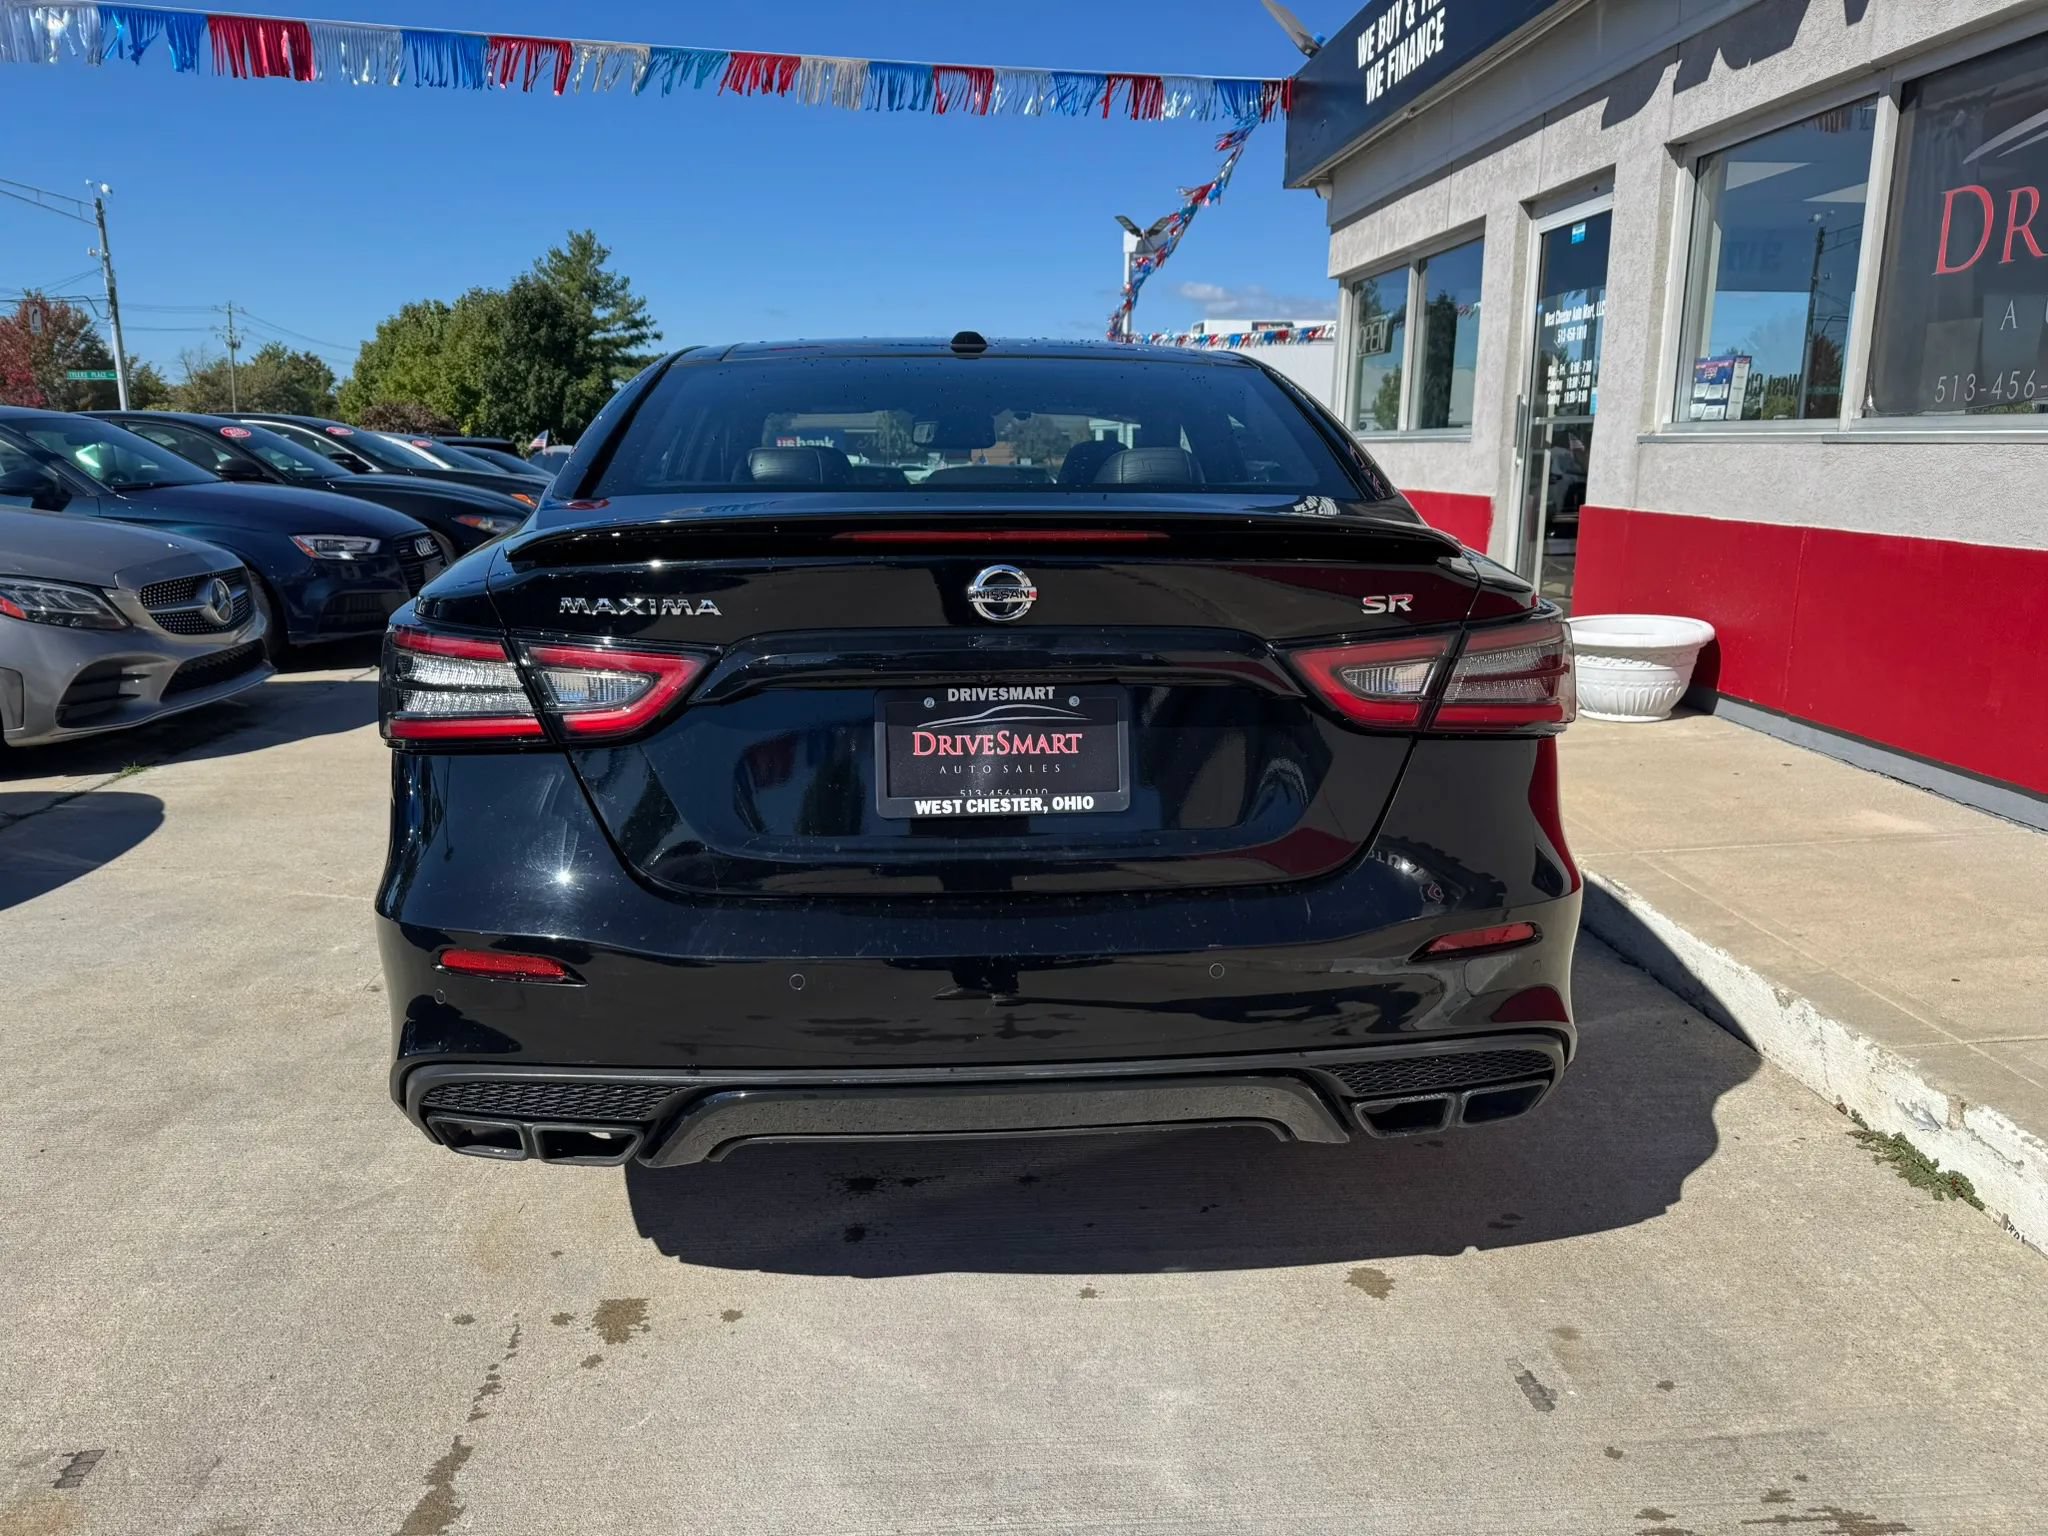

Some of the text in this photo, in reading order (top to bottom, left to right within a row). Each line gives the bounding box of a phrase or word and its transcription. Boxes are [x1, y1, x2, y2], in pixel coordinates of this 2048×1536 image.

[1358, 0, 1416, 69] WE BUY &
[1366, 6, 1446, 105] WE FINANCE
[1931, 184, 2048, 276] DR
[1358, 319, 1388, 354] OPEN
[976, 590, 1030, 599] NISSAN
[1361, 594, 1414, 614] SR
[559, 597, 723, 616] MAXIMA
[948, 686, 1056, 702] DRIVESMART
[939, 763, 1061, 775] AUTO SALES
[914, 796, 1095, 815] WEST CHESTER, OHIO
